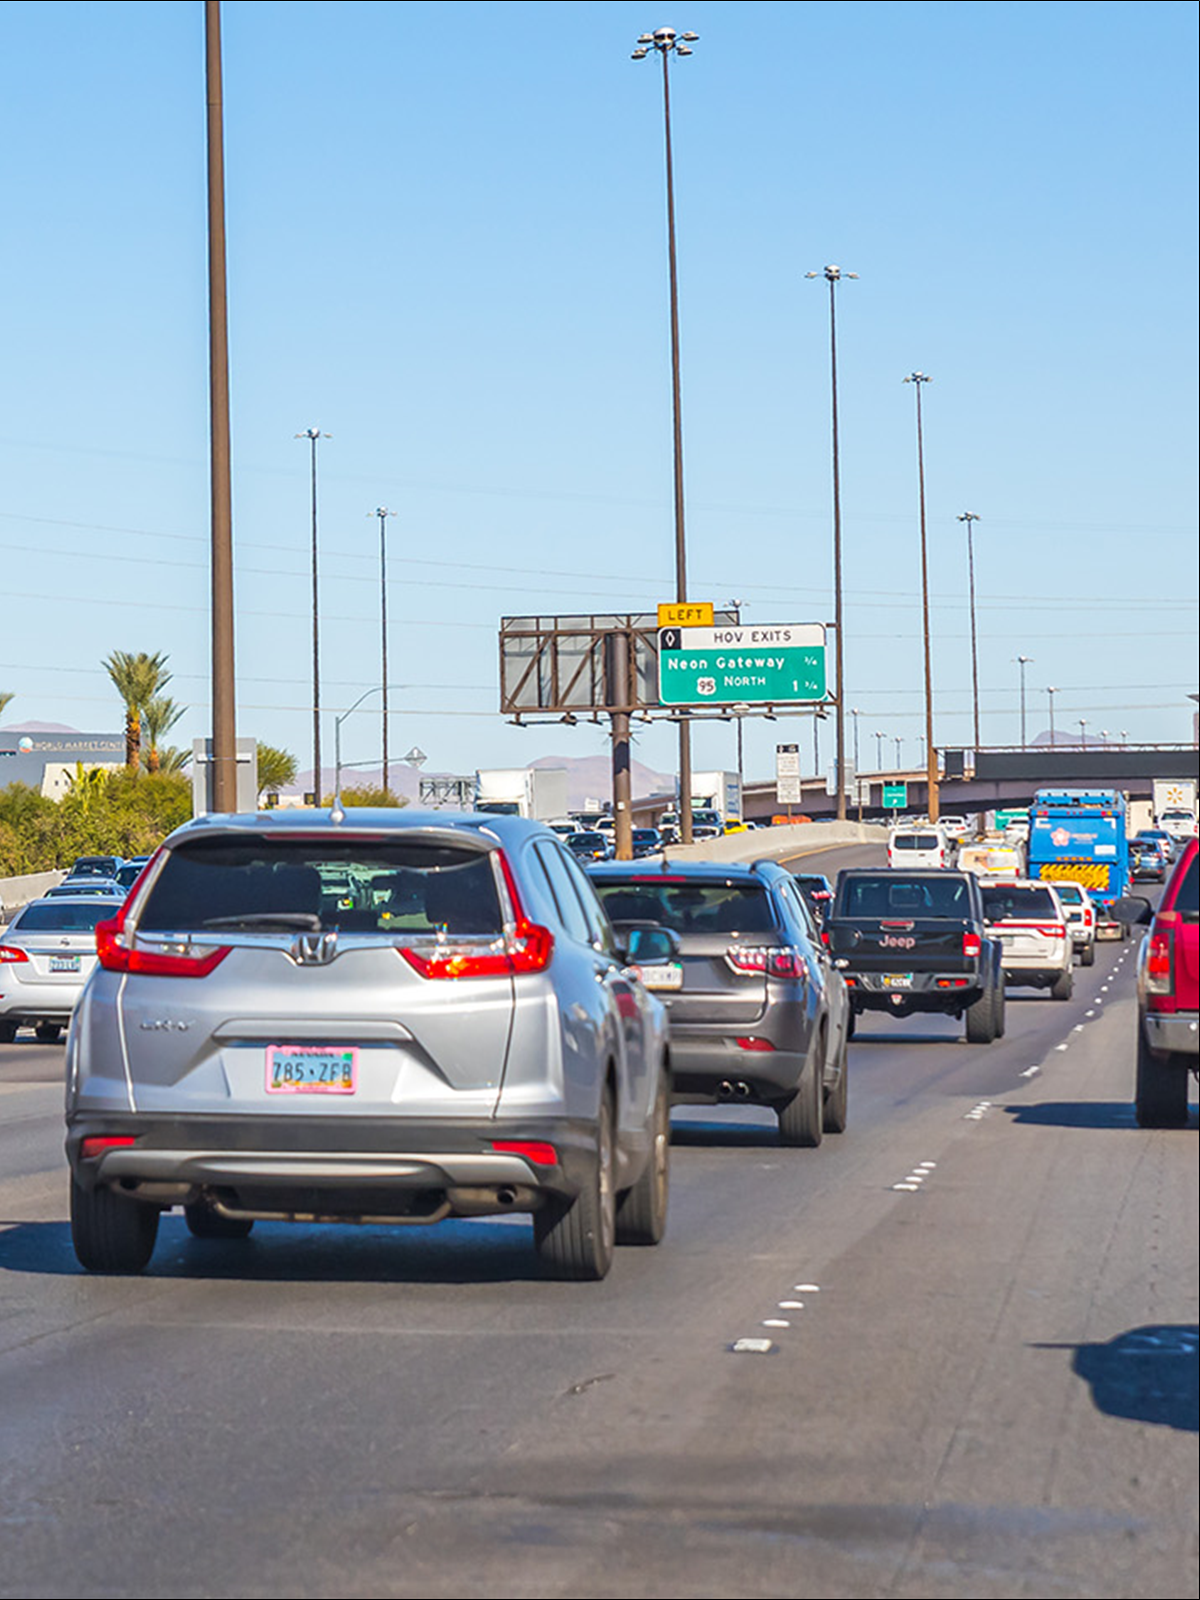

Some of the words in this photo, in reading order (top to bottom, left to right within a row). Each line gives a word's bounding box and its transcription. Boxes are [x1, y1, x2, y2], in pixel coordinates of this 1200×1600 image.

[668, 609, 703, 621] LEFT
[714, 632, 744, 644] HOV
[751, 630, 792, 643] EXITS
[668, 657, 708, 670] Neon
[716, 656, 785, 670] Gateway
[699, 680, 715, 693] 95
[724, 676, 766, 687] NORTH
[792, 680, 798, 692] 1
[65, 741, 98, 751] MARKET
[879, 934, 916, 949] Jeep
